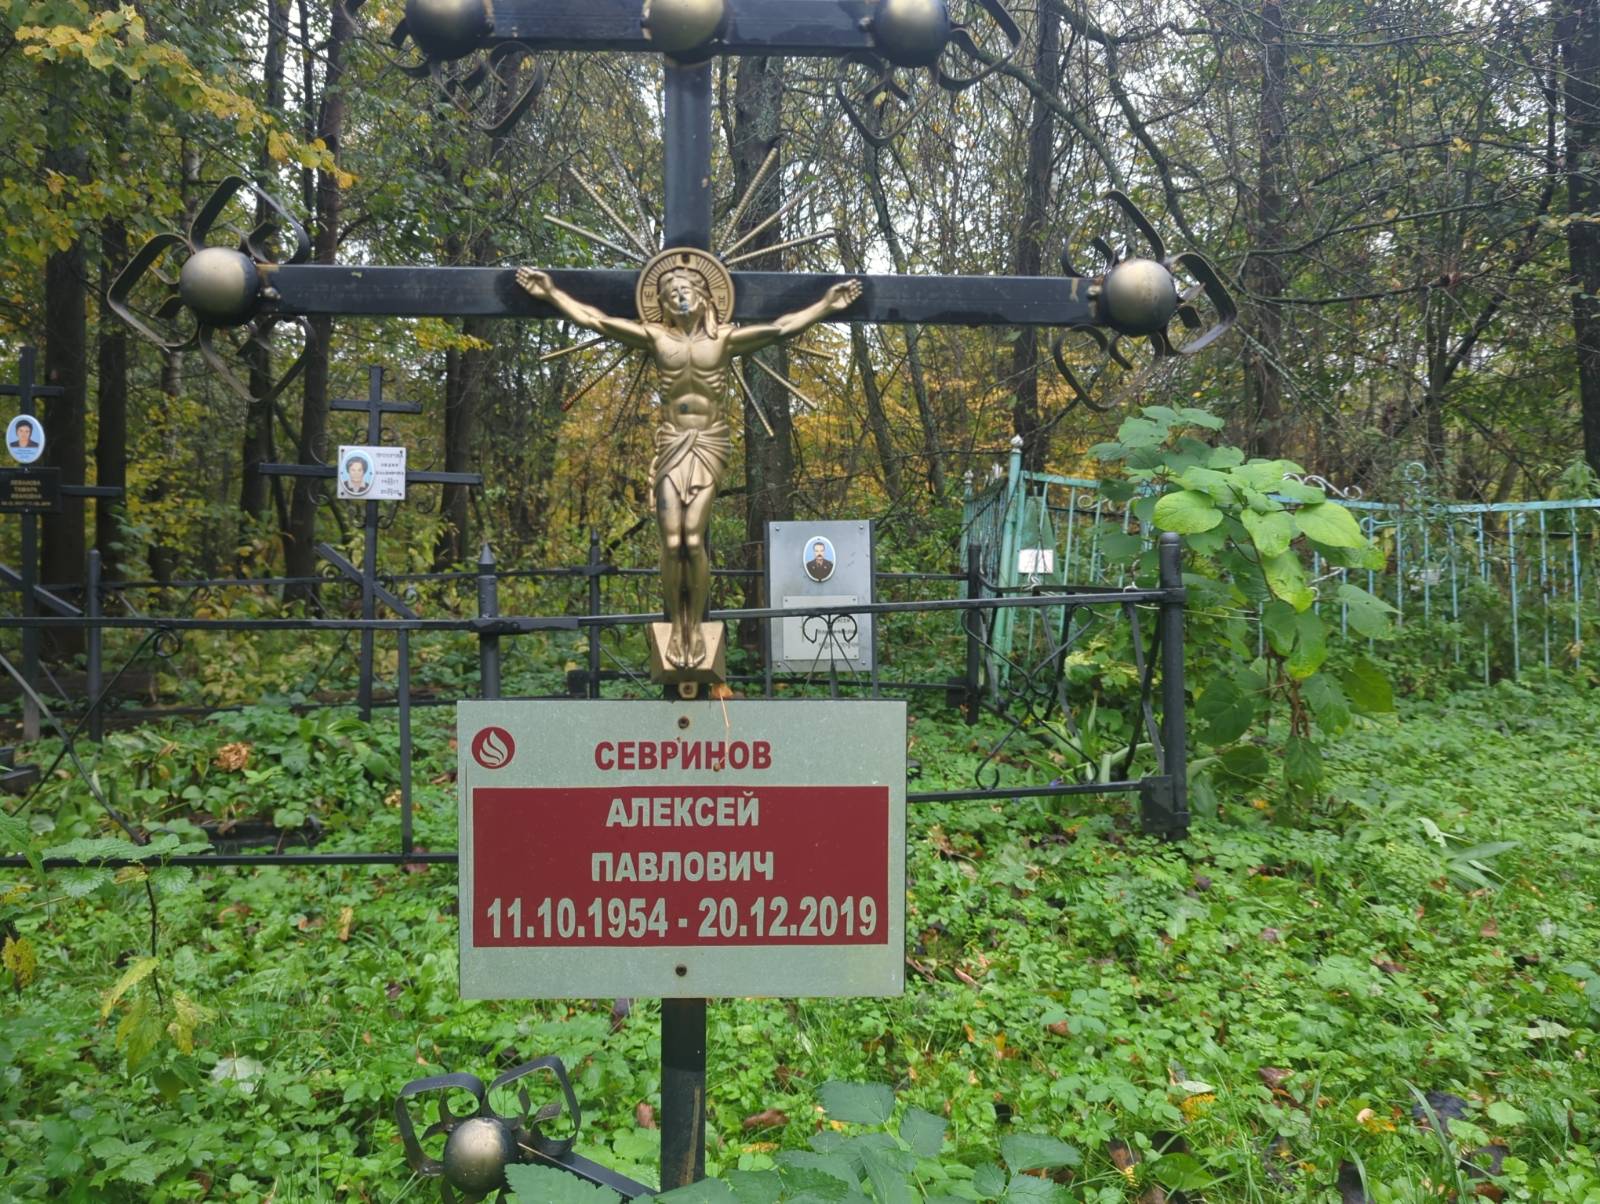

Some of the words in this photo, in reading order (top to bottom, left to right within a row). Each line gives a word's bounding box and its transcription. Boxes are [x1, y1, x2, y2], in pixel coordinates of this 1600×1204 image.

[594, 740, 773, 770] СЕВРИНОВ
[605, 791, 760, 828] АЛЕКСЕЙ
[591, 851, 774, 882] ПАВЛОВИЧ
[487, 897, 669, 939] 11.10.1954
[678, 918, 688, 928] -
[697, 895, 878, 938] 20.12.2019
